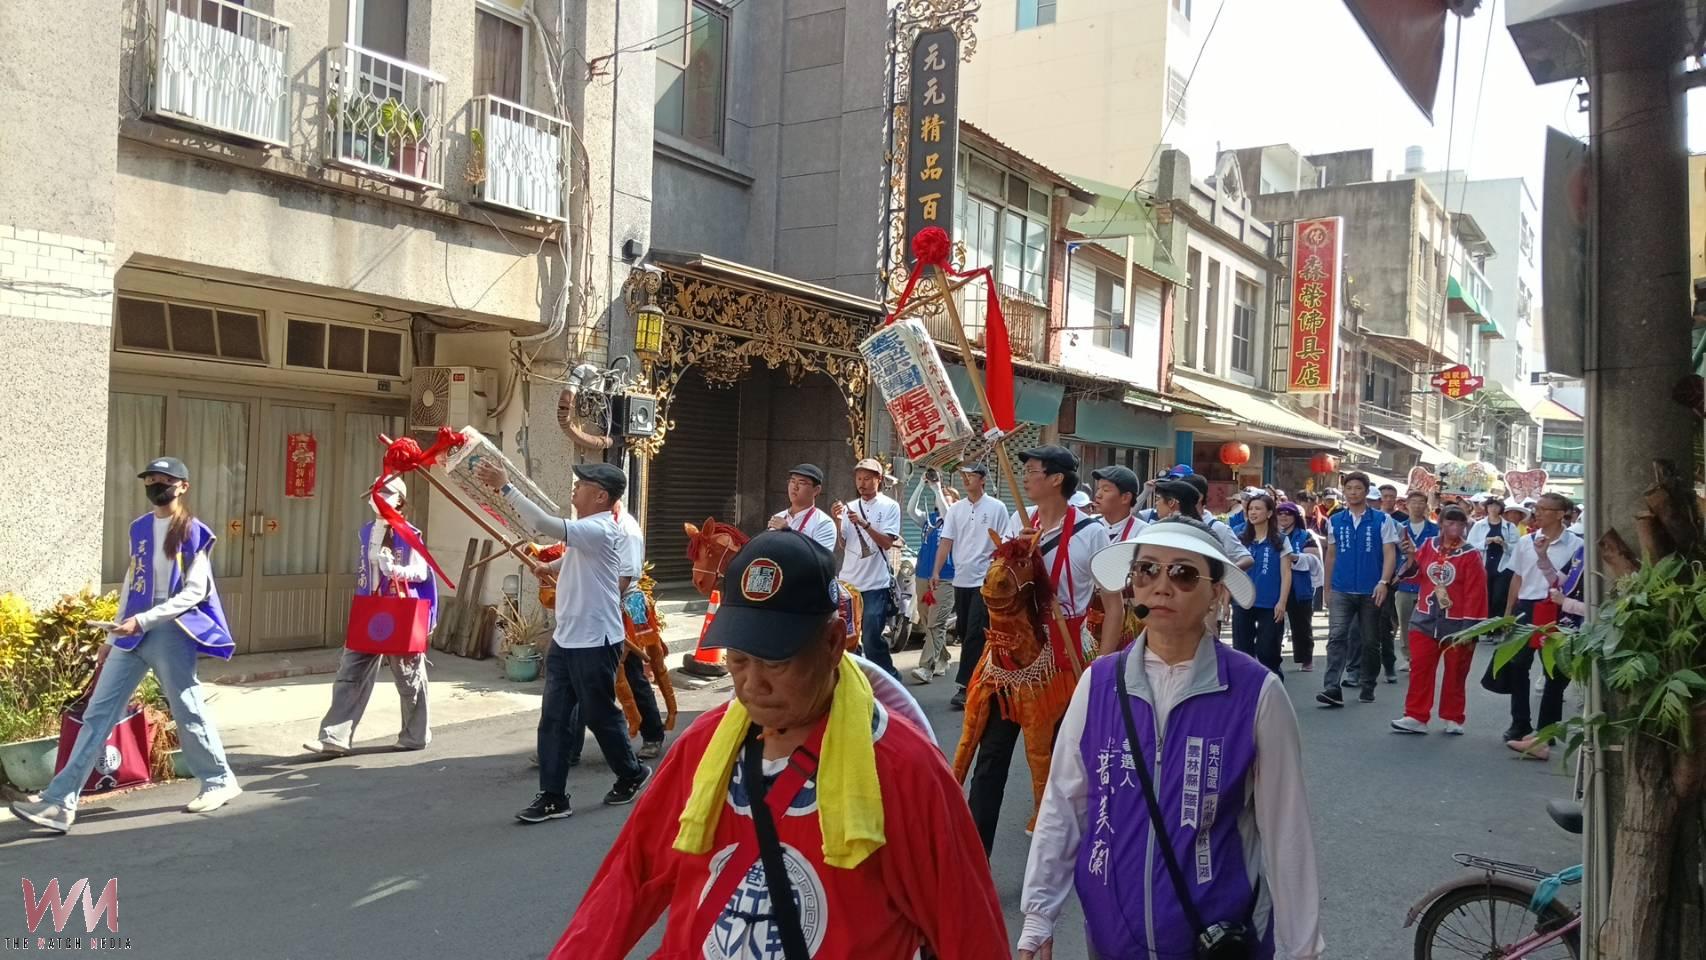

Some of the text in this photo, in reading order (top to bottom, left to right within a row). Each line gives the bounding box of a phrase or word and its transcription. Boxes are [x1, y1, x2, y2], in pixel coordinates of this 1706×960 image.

[918, 43, 946, 221] 元元精品百
[1296, 255, 1329, 387] 森榮佛具店
[1448, 380, 1461, 397] 民宿
